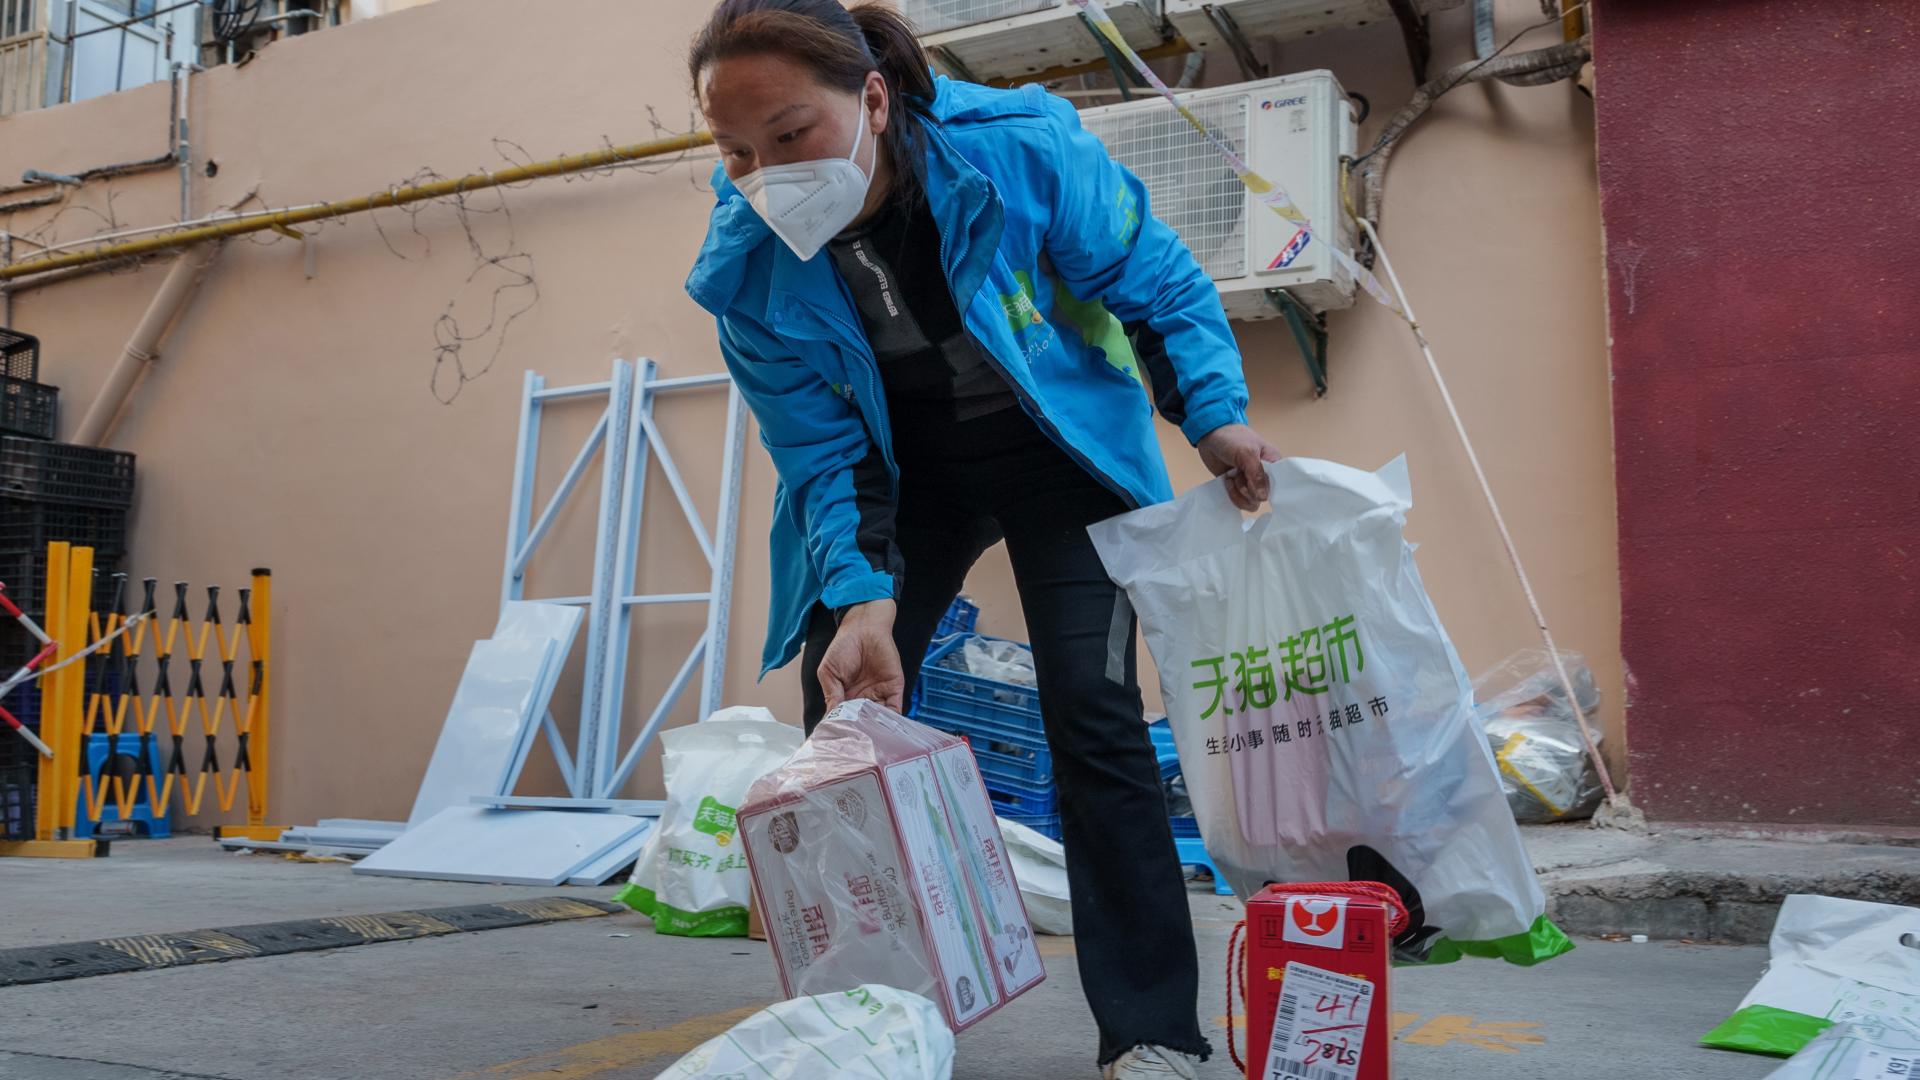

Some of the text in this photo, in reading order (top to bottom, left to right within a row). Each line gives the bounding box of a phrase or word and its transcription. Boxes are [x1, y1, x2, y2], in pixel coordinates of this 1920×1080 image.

[1274, 96, 1307, 109] GREE
[1191, 614, 1364, 720] 天猫超市
[1315, 993, 1360, 1021] 41
